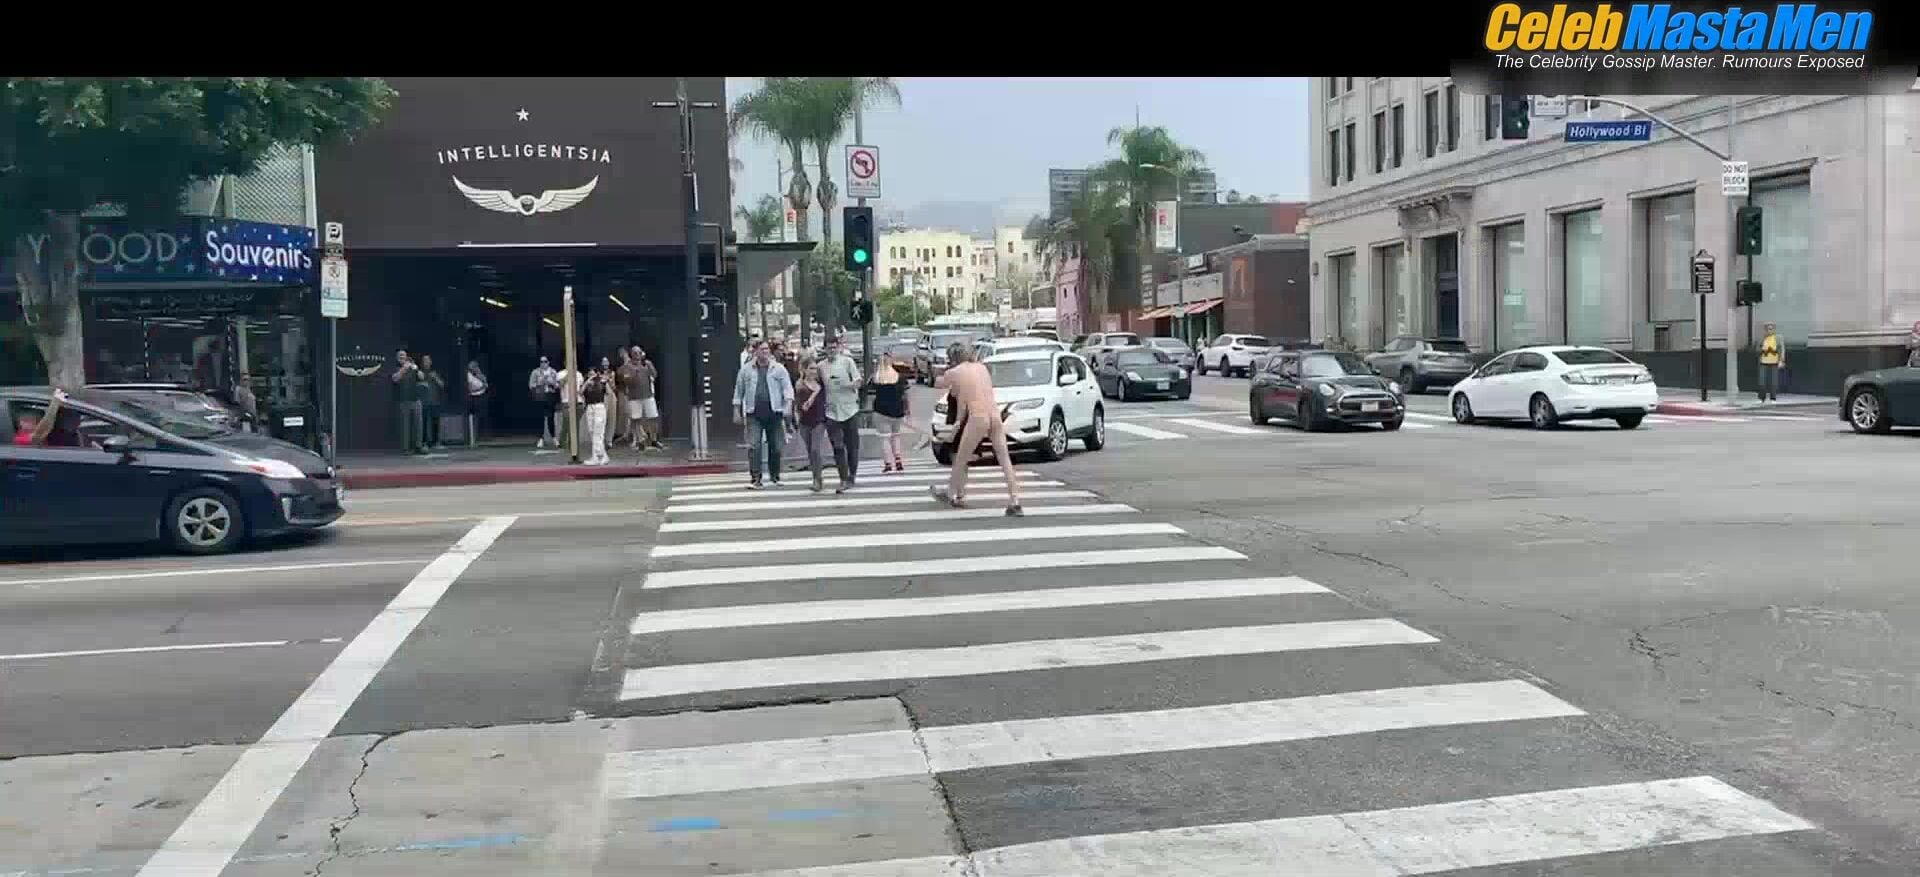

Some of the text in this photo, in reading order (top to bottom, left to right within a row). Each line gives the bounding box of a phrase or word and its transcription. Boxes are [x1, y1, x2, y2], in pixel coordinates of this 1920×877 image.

[1570, 124, 1631, 139] Hollywood
[437, 143, 612, 165] INTELLIGENTSIA
[206, 230, 313, 269] Souvenirs
